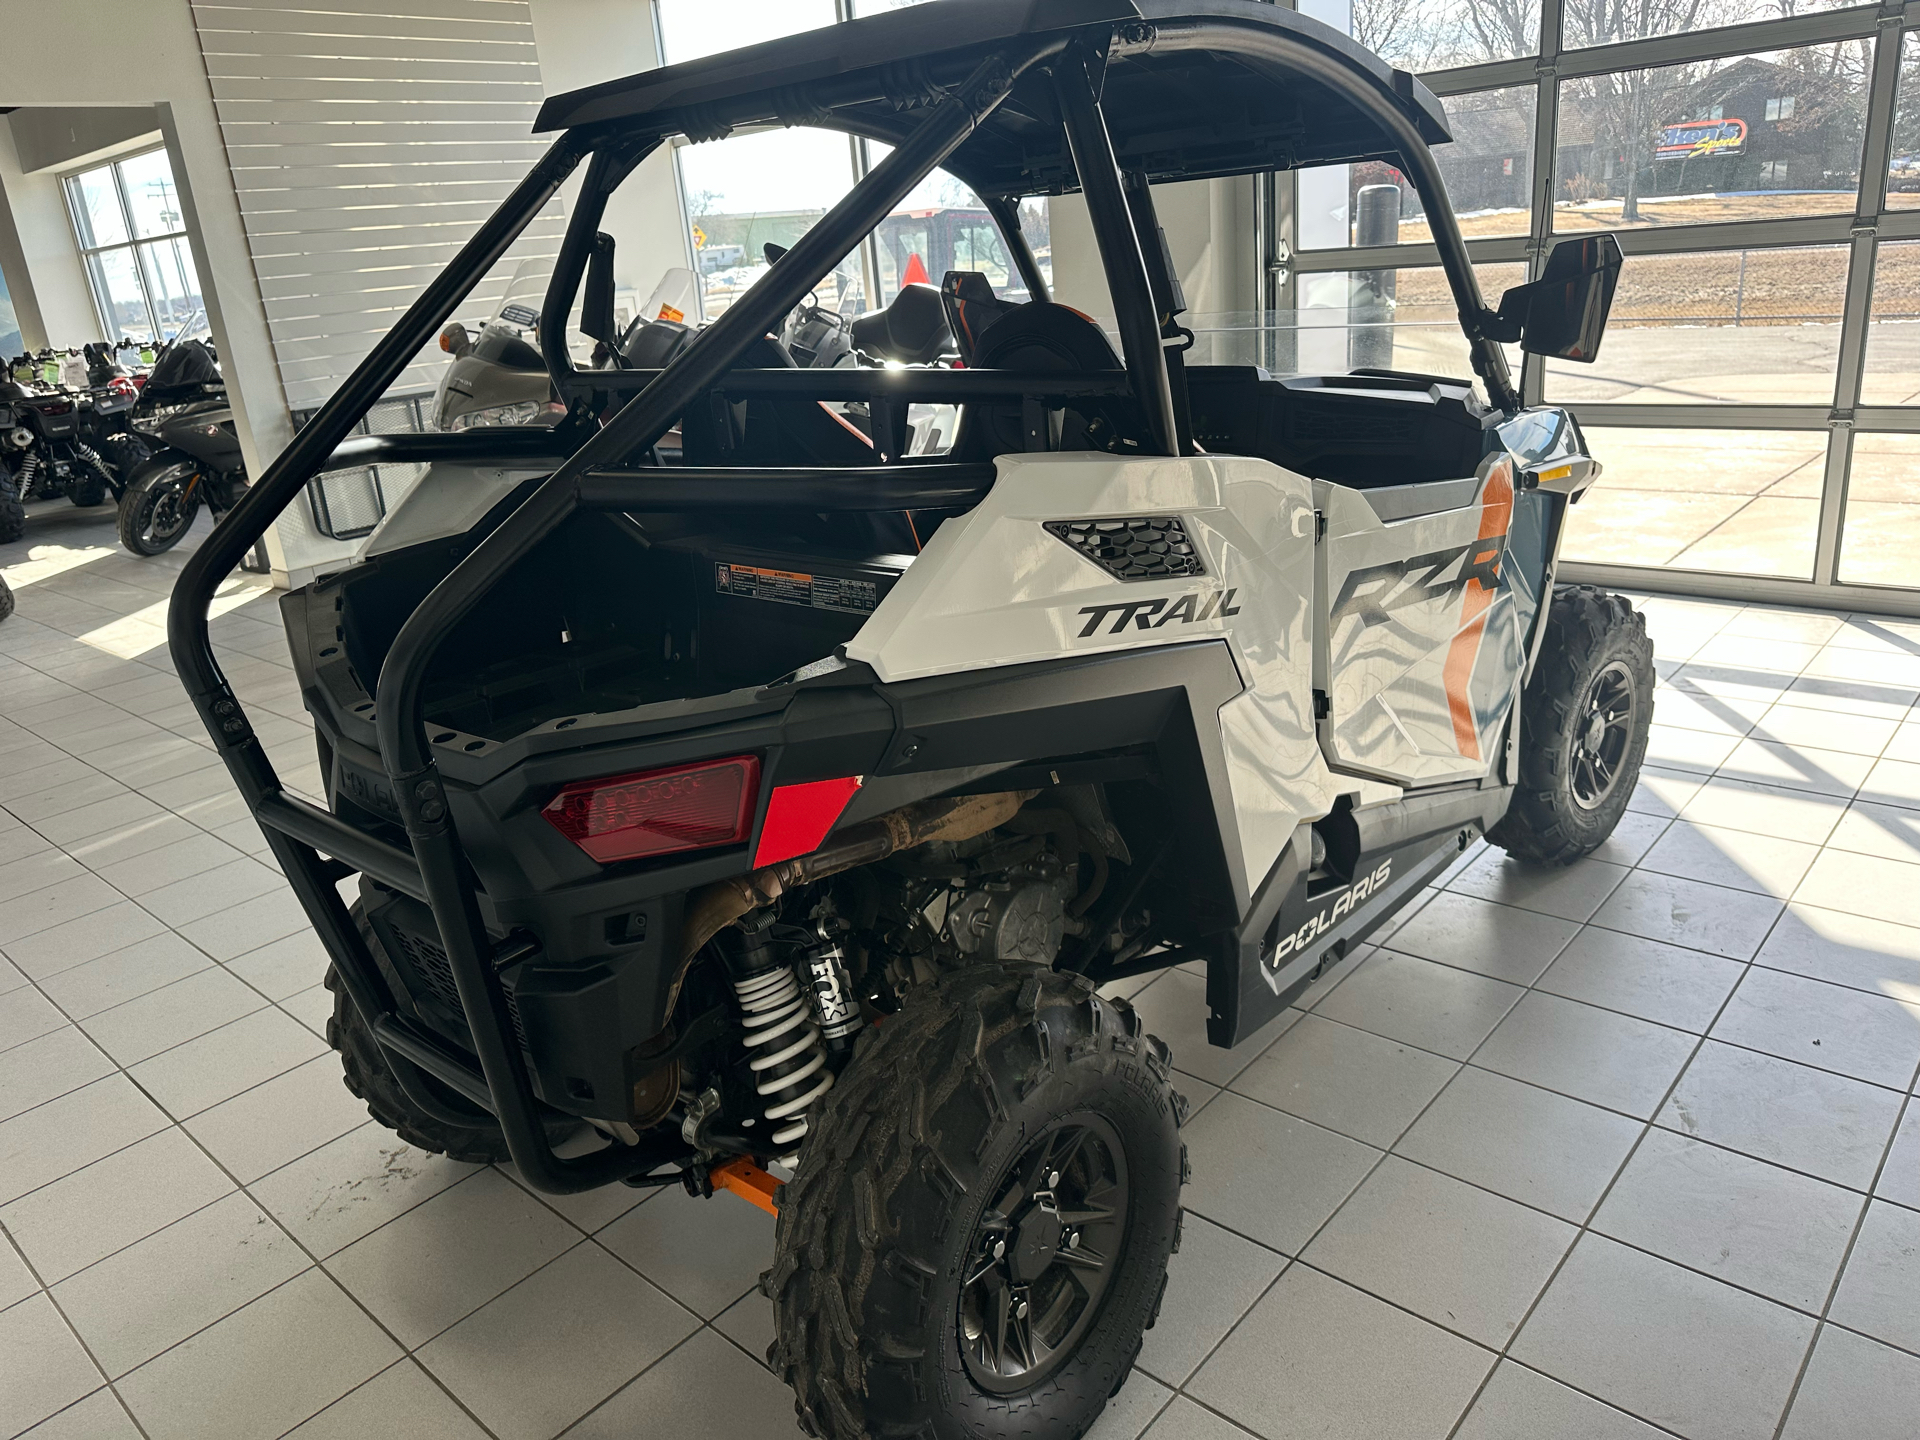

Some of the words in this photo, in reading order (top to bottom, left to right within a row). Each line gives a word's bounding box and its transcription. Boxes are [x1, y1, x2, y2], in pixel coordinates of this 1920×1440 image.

[1687, 136, 1741, 158] Sports
[1077, 588, 1242, 638] TRAIL
[1330, 534, 1507, 640] RZR
[1272, 857, 1393, 969] POLARIS
[811, 958, 848, 1022] FOX
